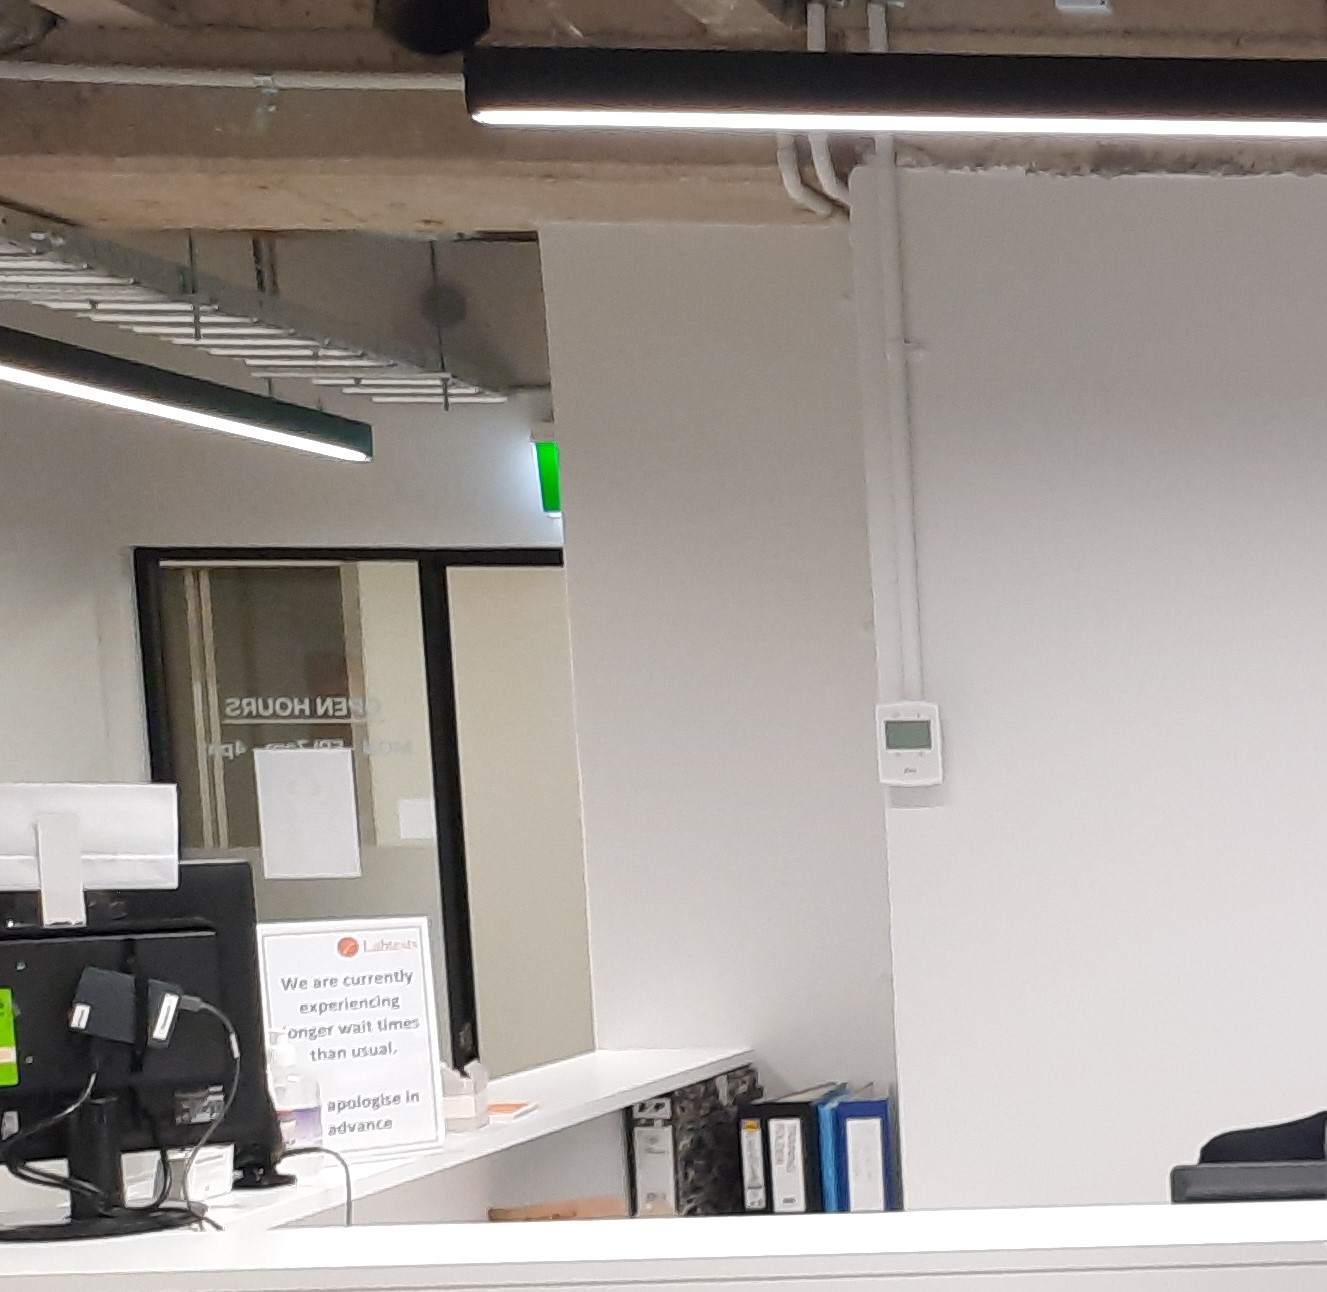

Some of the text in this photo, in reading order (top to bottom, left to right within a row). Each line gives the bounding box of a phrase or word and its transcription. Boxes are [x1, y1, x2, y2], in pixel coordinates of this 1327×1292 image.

[281, 969, 414, 991] We are currently
[299, 995, 400, 1014] experiencing
[282, 1017, 420, 1041] onger wait times
[309, 1047, 347, 1062] than
[326, 1089, 420, 1114] apologise in
[327, 1118, 393, 1136] advance
